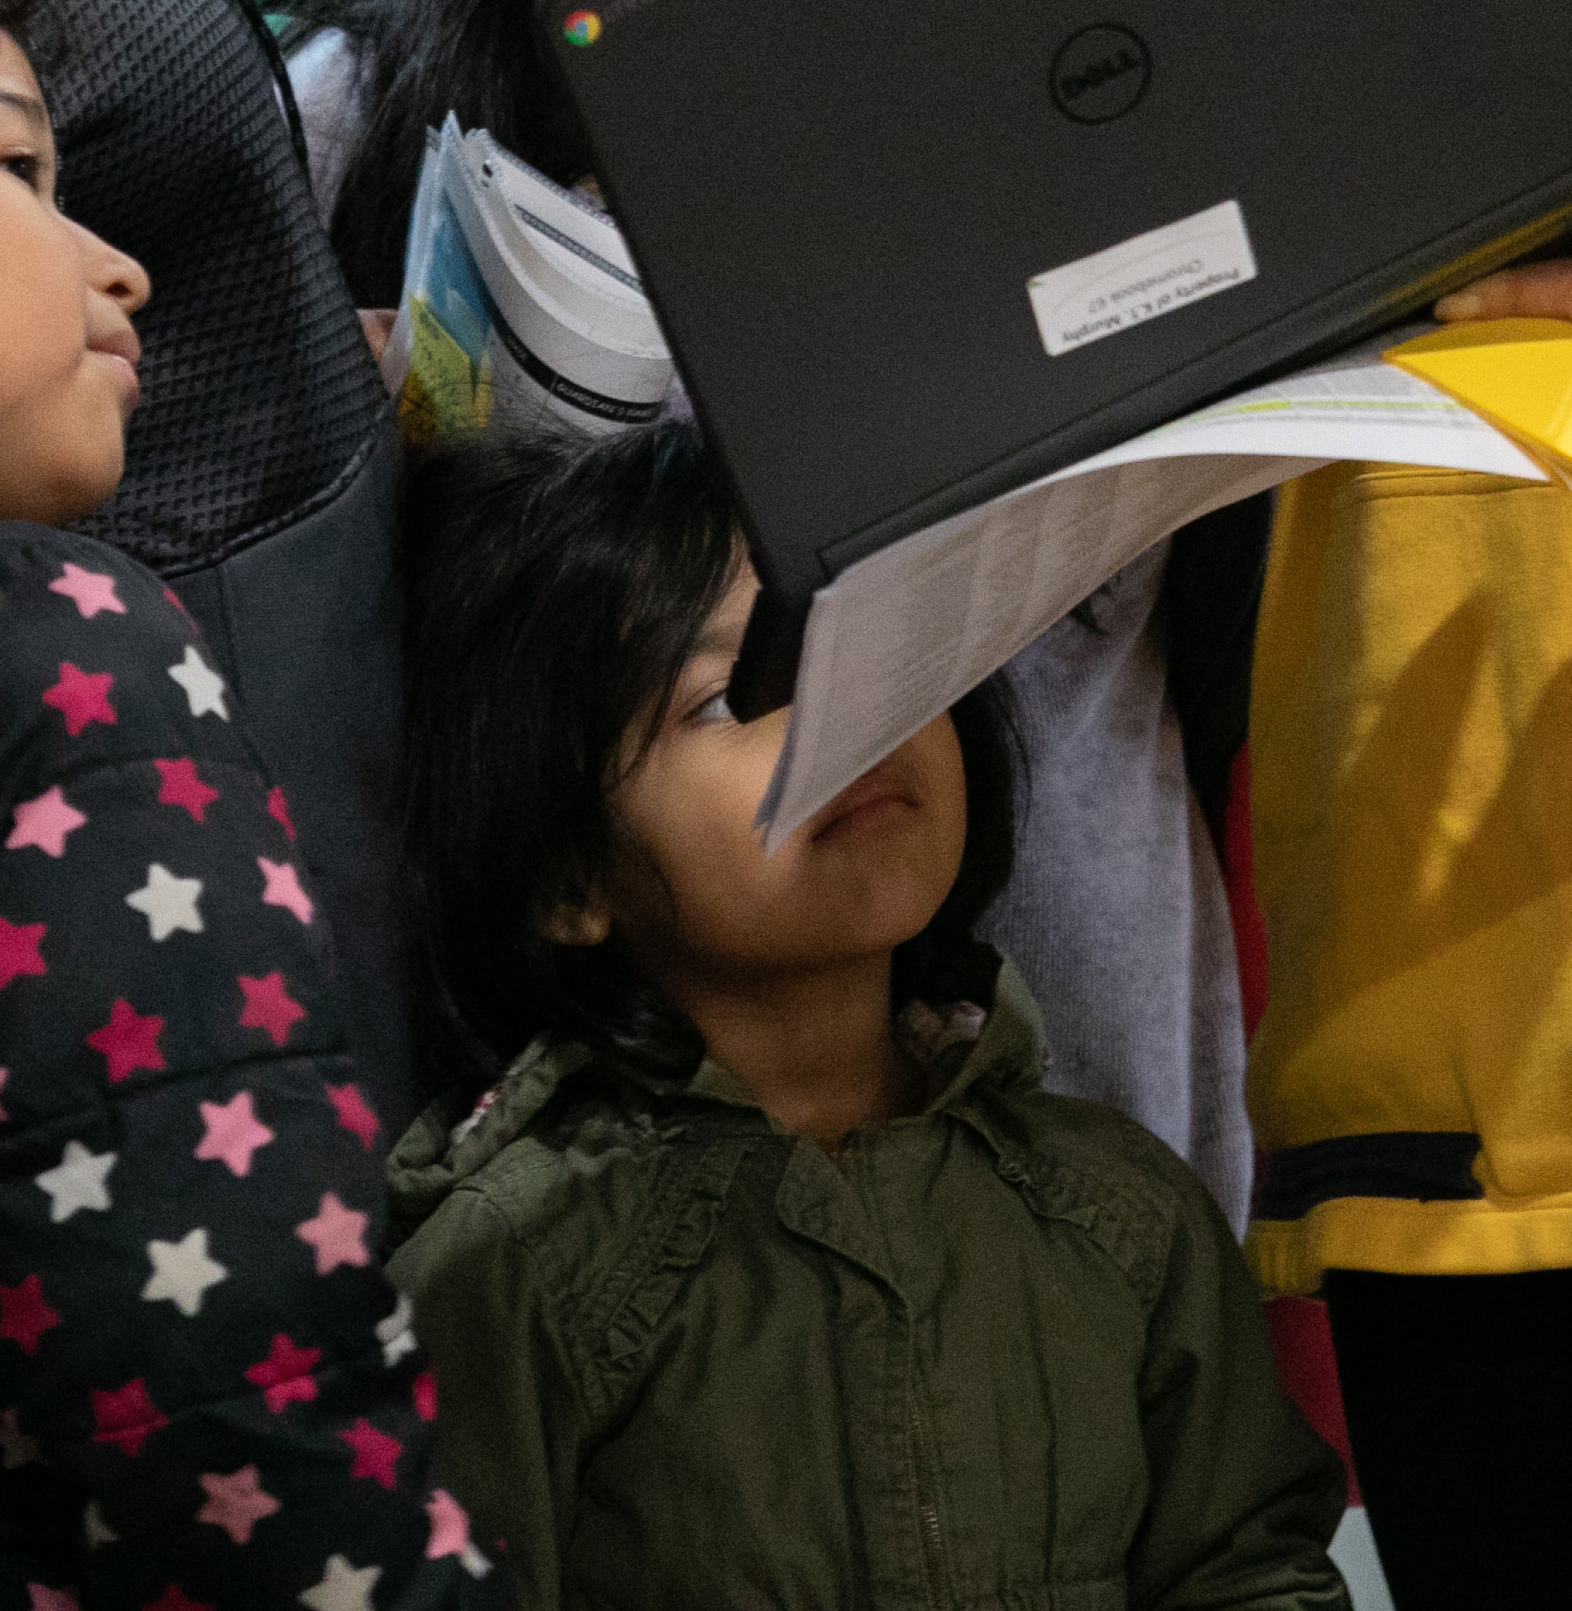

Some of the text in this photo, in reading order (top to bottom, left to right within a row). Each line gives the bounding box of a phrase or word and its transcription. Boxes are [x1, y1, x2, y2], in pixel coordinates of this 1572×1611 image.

[1109, 258, 1204, 302] Chromebook
[1175, 267, 1240, 298] Property
[1155, 293, 1172, 310] of
[1062, 314, 1122, 342] Murphy
